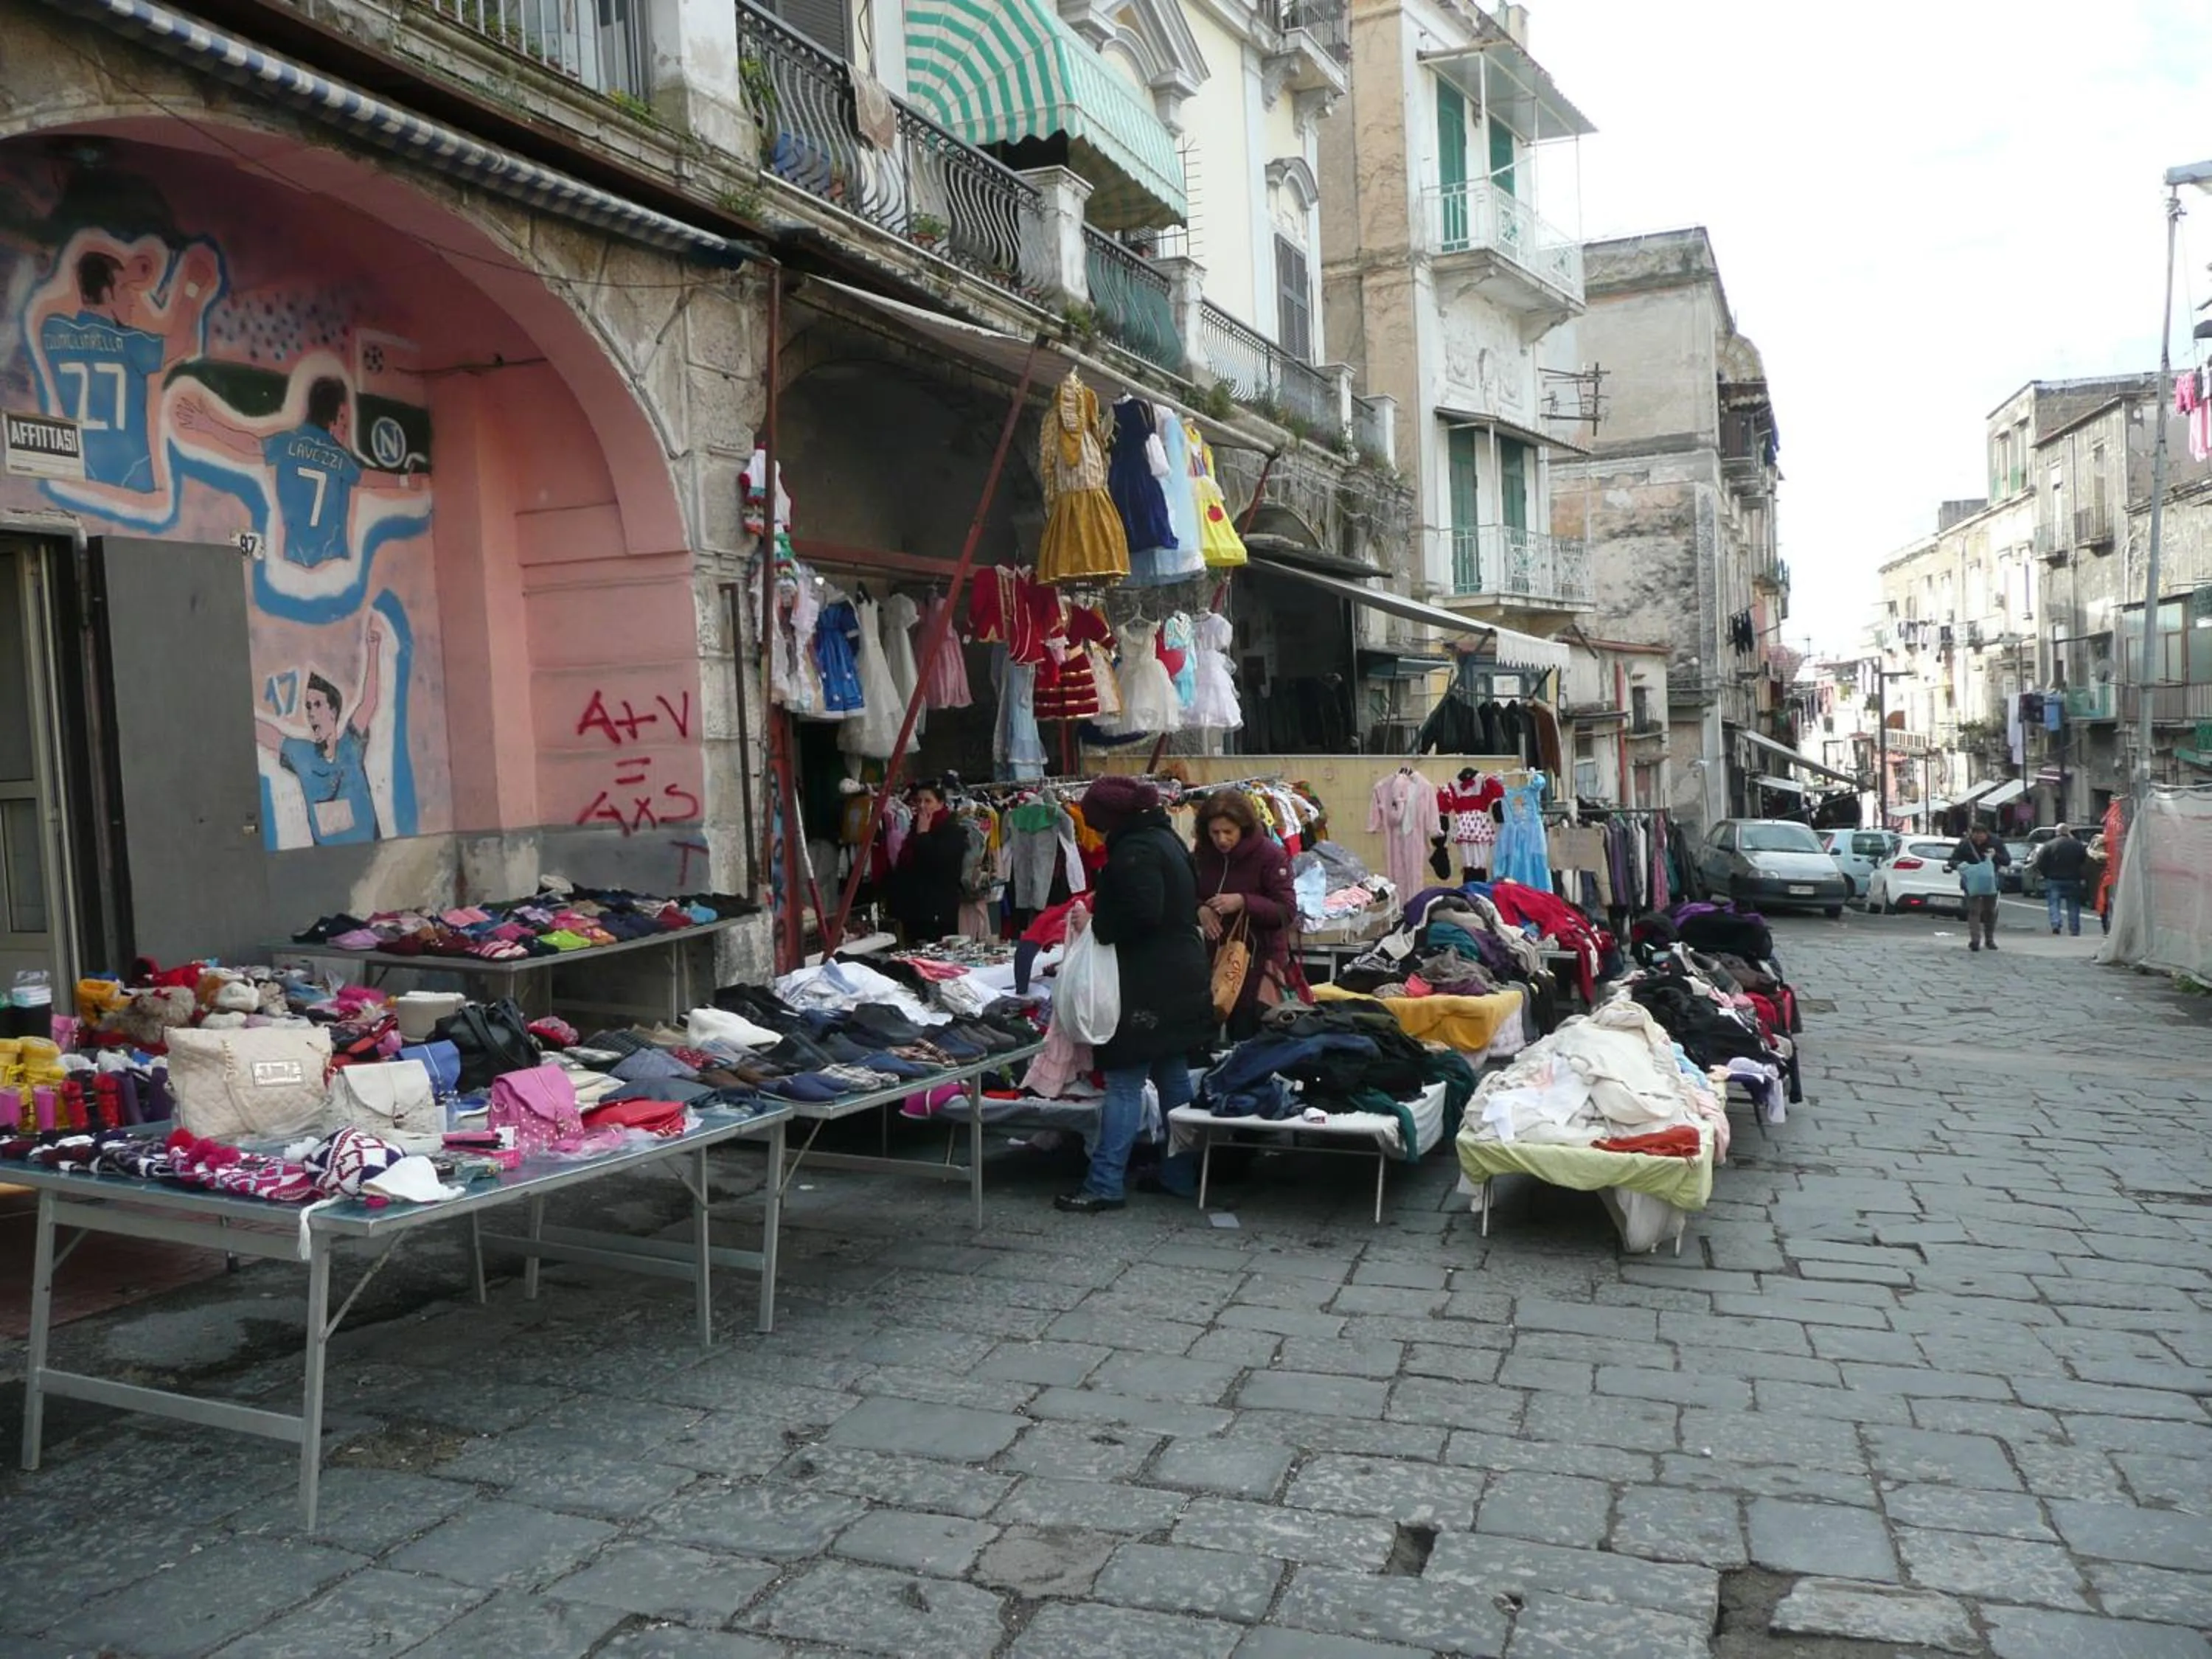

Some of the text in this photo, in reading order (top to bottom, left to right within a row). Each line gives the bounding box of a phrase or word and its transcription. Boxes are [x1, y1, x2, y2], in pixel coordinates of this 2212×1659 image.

[59, 362, 125, 431] 27
[11, 421, 78, 452] AFFITTASI
[288, 441, 344, 470] LAVEZZI
[297, 467, 327, 526] 7
[265, 669, 297, 716] 17
